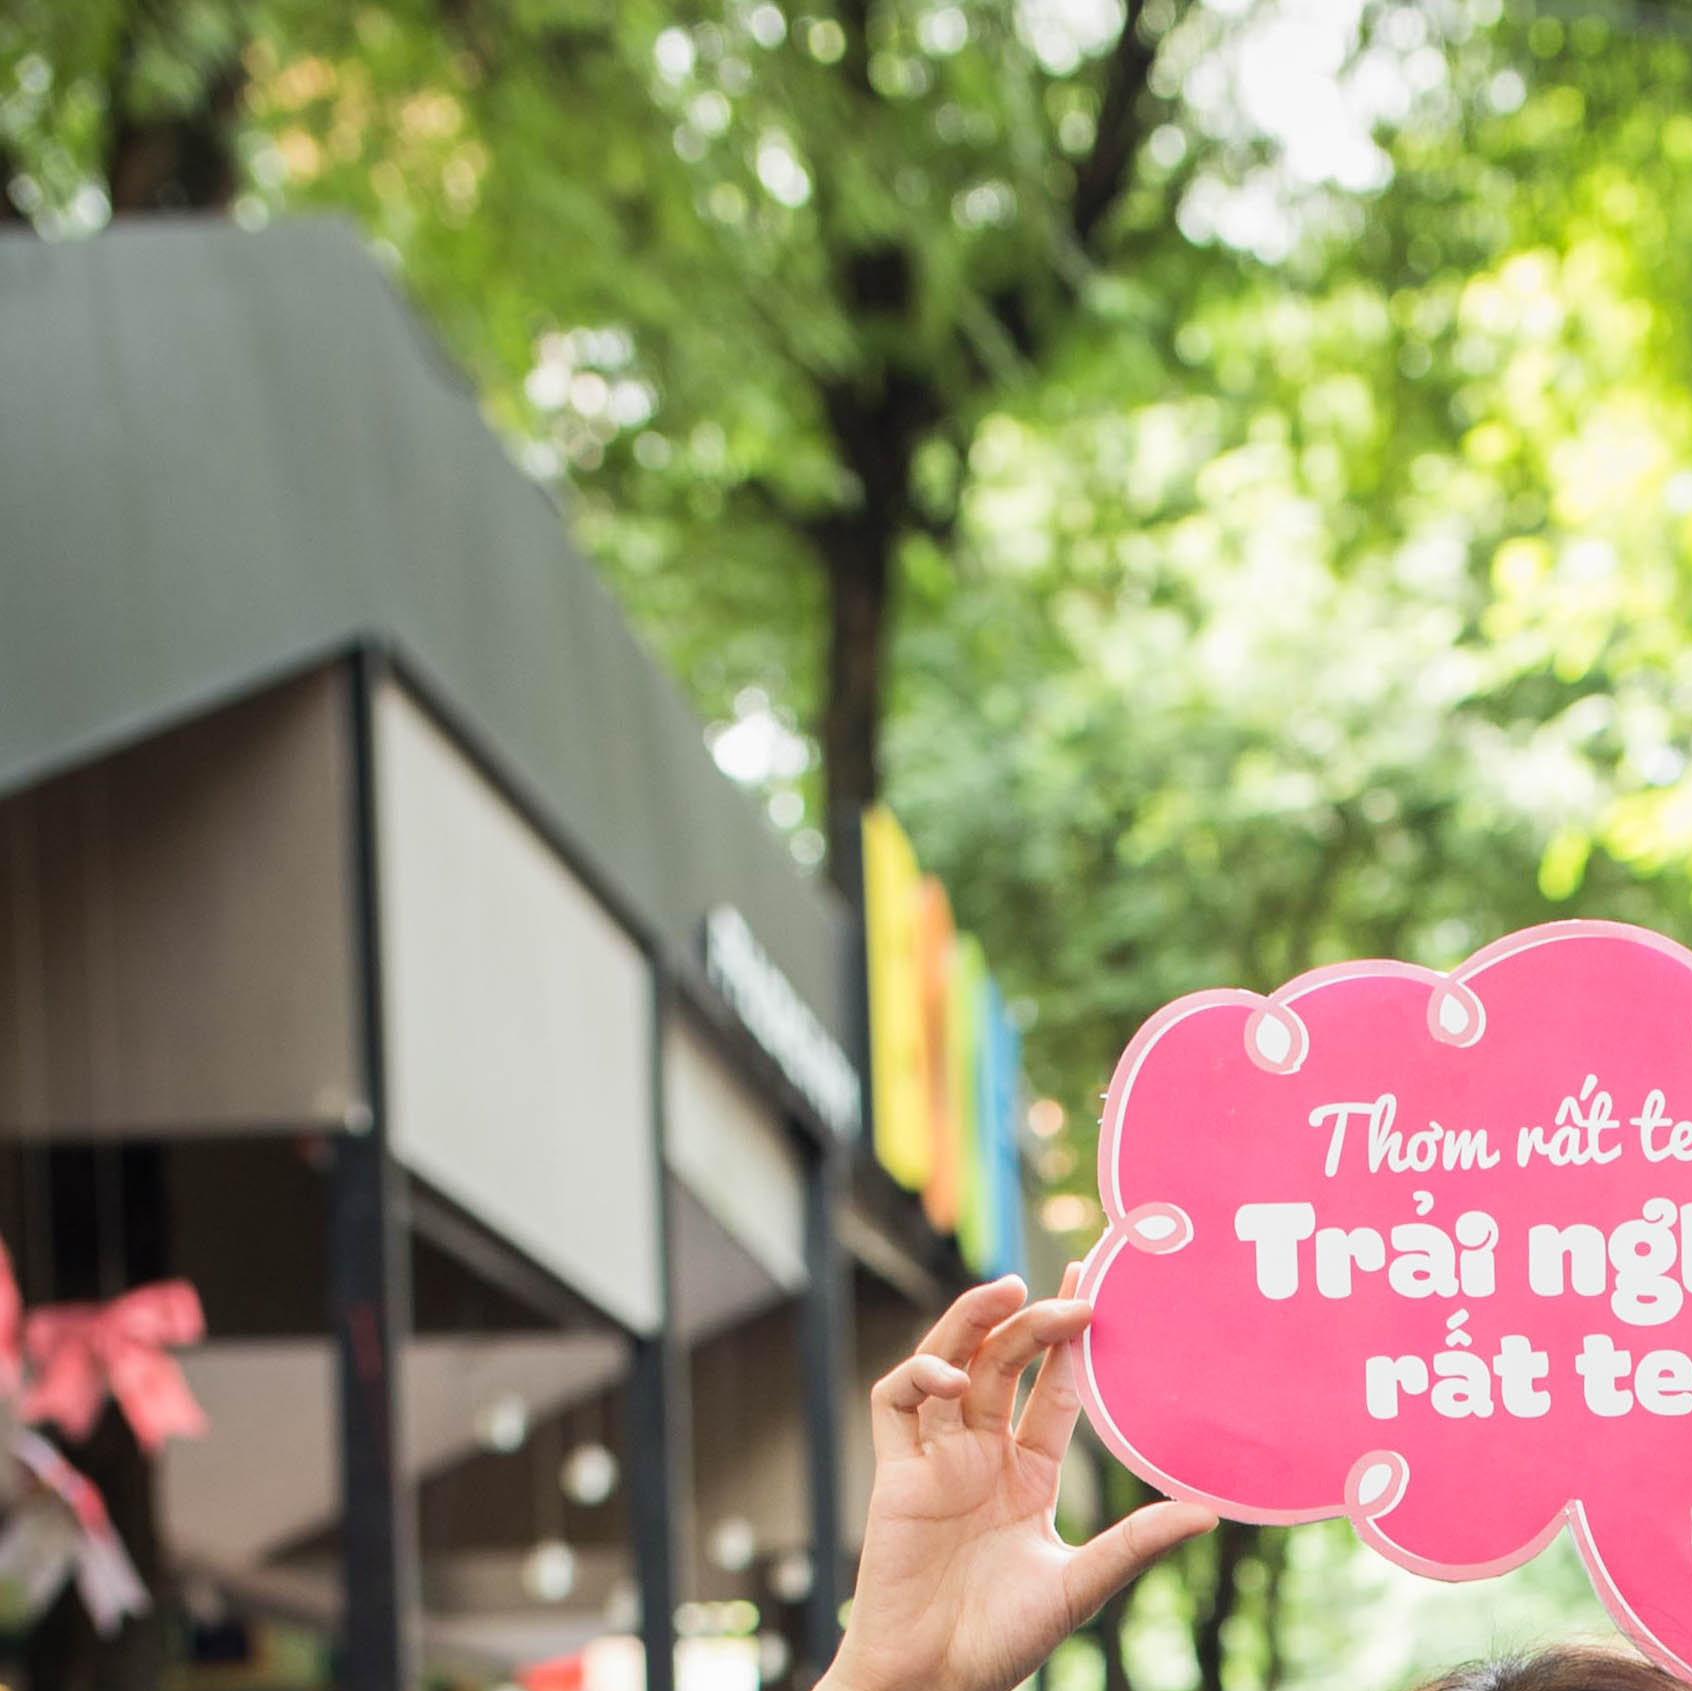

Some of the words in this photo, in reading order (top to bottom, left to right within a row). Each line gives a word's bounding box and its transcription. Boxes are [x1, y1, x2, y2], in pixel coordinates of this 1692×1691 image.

[1308, 1093, 1501, 1178] Thơm
[1516, 1073, 1622, 1169] rất
[1234, 1190, 1499, 1300] Trải
[1365, 1308, 1551, 1420] rất
